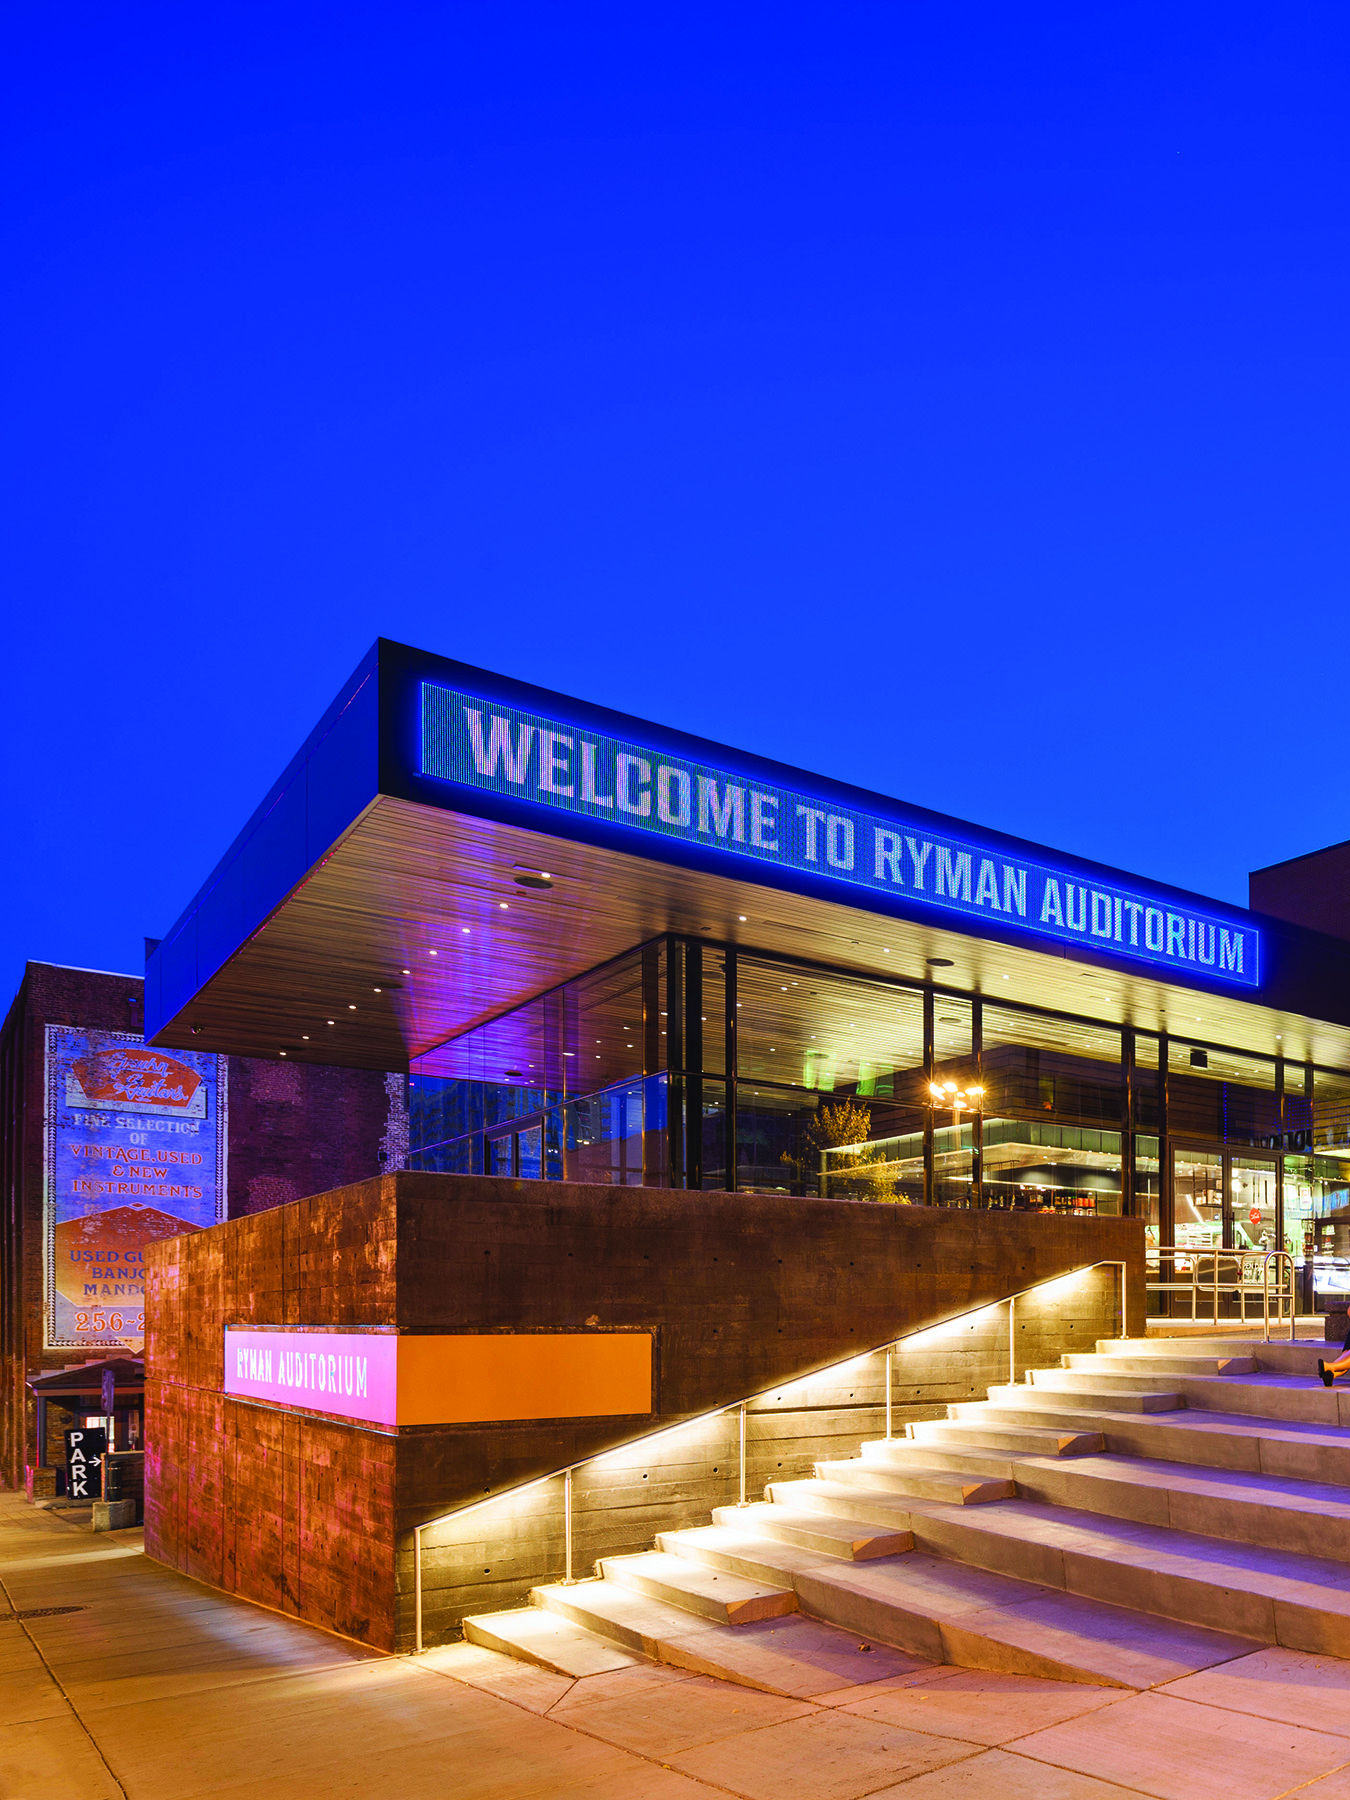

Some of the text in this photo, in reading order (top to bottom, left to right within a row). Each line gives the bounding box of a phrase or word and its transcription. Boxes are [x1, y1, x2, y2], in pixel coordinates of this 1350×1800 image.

[462, 706, 1244, 974] WELCOME TO RYMAN AUDITORIUM
[74, 1113, 200, 1135] FINE SELECTION
[130, 1132, 148, 1145] OF
[157, 1150, 202, 1165] USED
[112, 1165, 169, 1180] & NEW
[72, 1179, 203, 1198] INSTRUMENTS
[70, 1250, 119, 1262] USED
[237, 1348, 367, 1398] RYMAN AUDITORIUM
[70, 1432, 88, 1497] PARK
